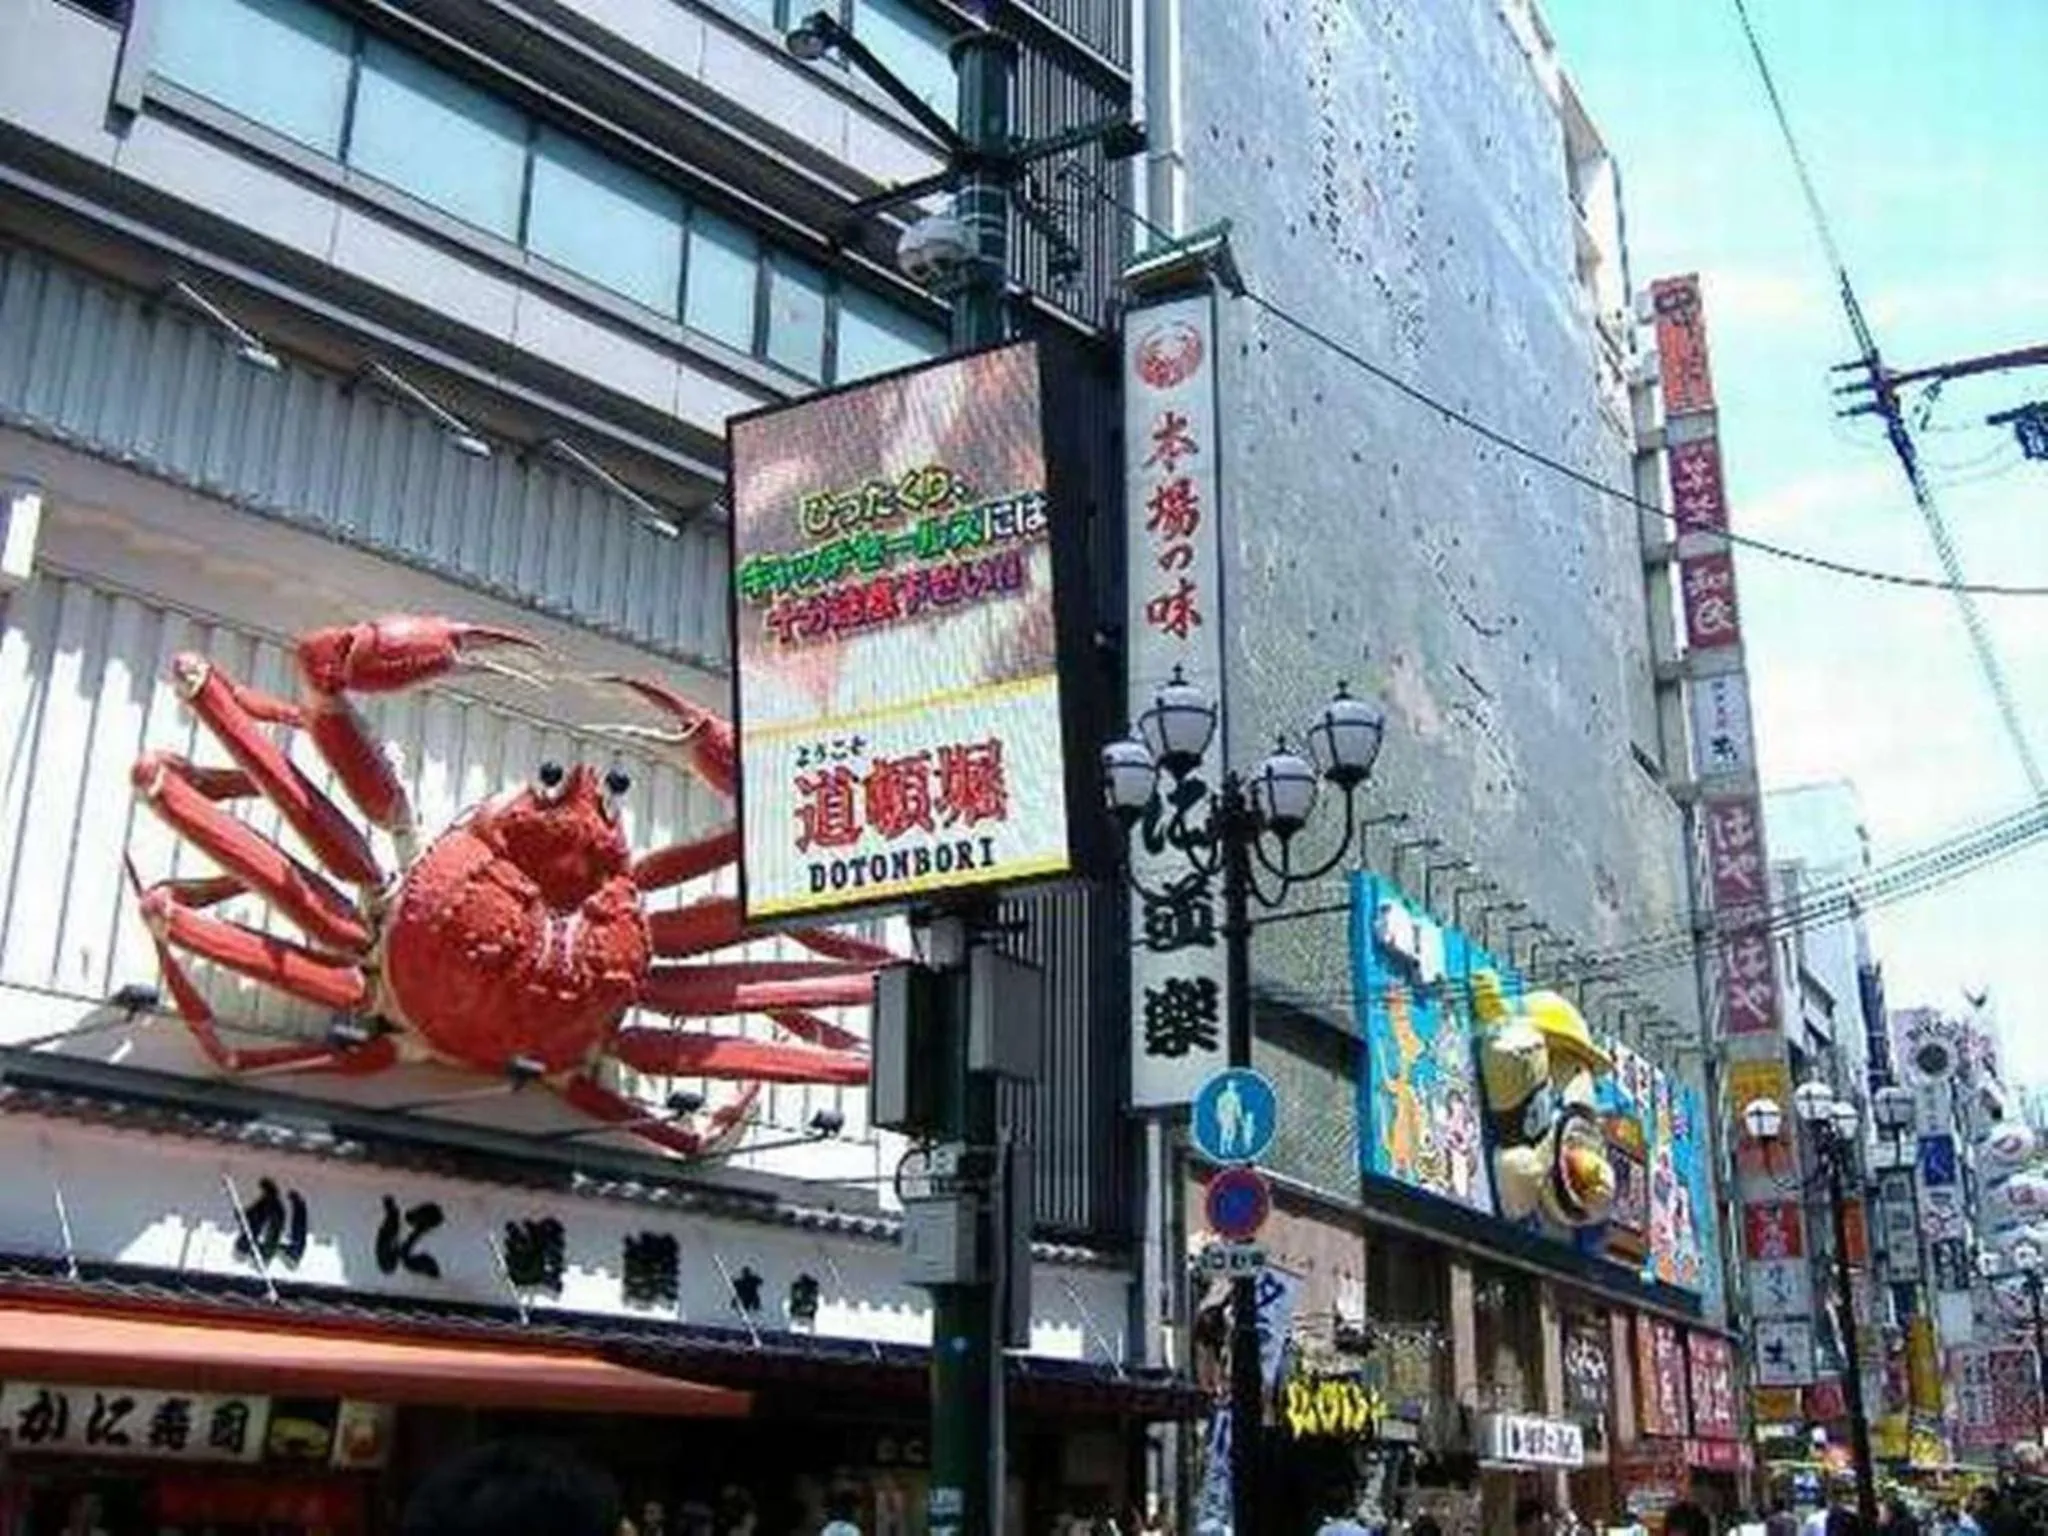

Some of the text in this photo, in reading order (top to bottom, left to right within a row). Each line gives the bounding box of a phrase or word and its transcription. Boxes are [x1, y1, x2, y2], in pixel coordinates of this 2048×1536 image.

[1144, 411, 1202, 640] 本場の味
[797, 736, 866, 767] ようこそ
[795, 738, 1008, 853] 道頓堀
[808, 837, 995, 893] DOTONBORI
